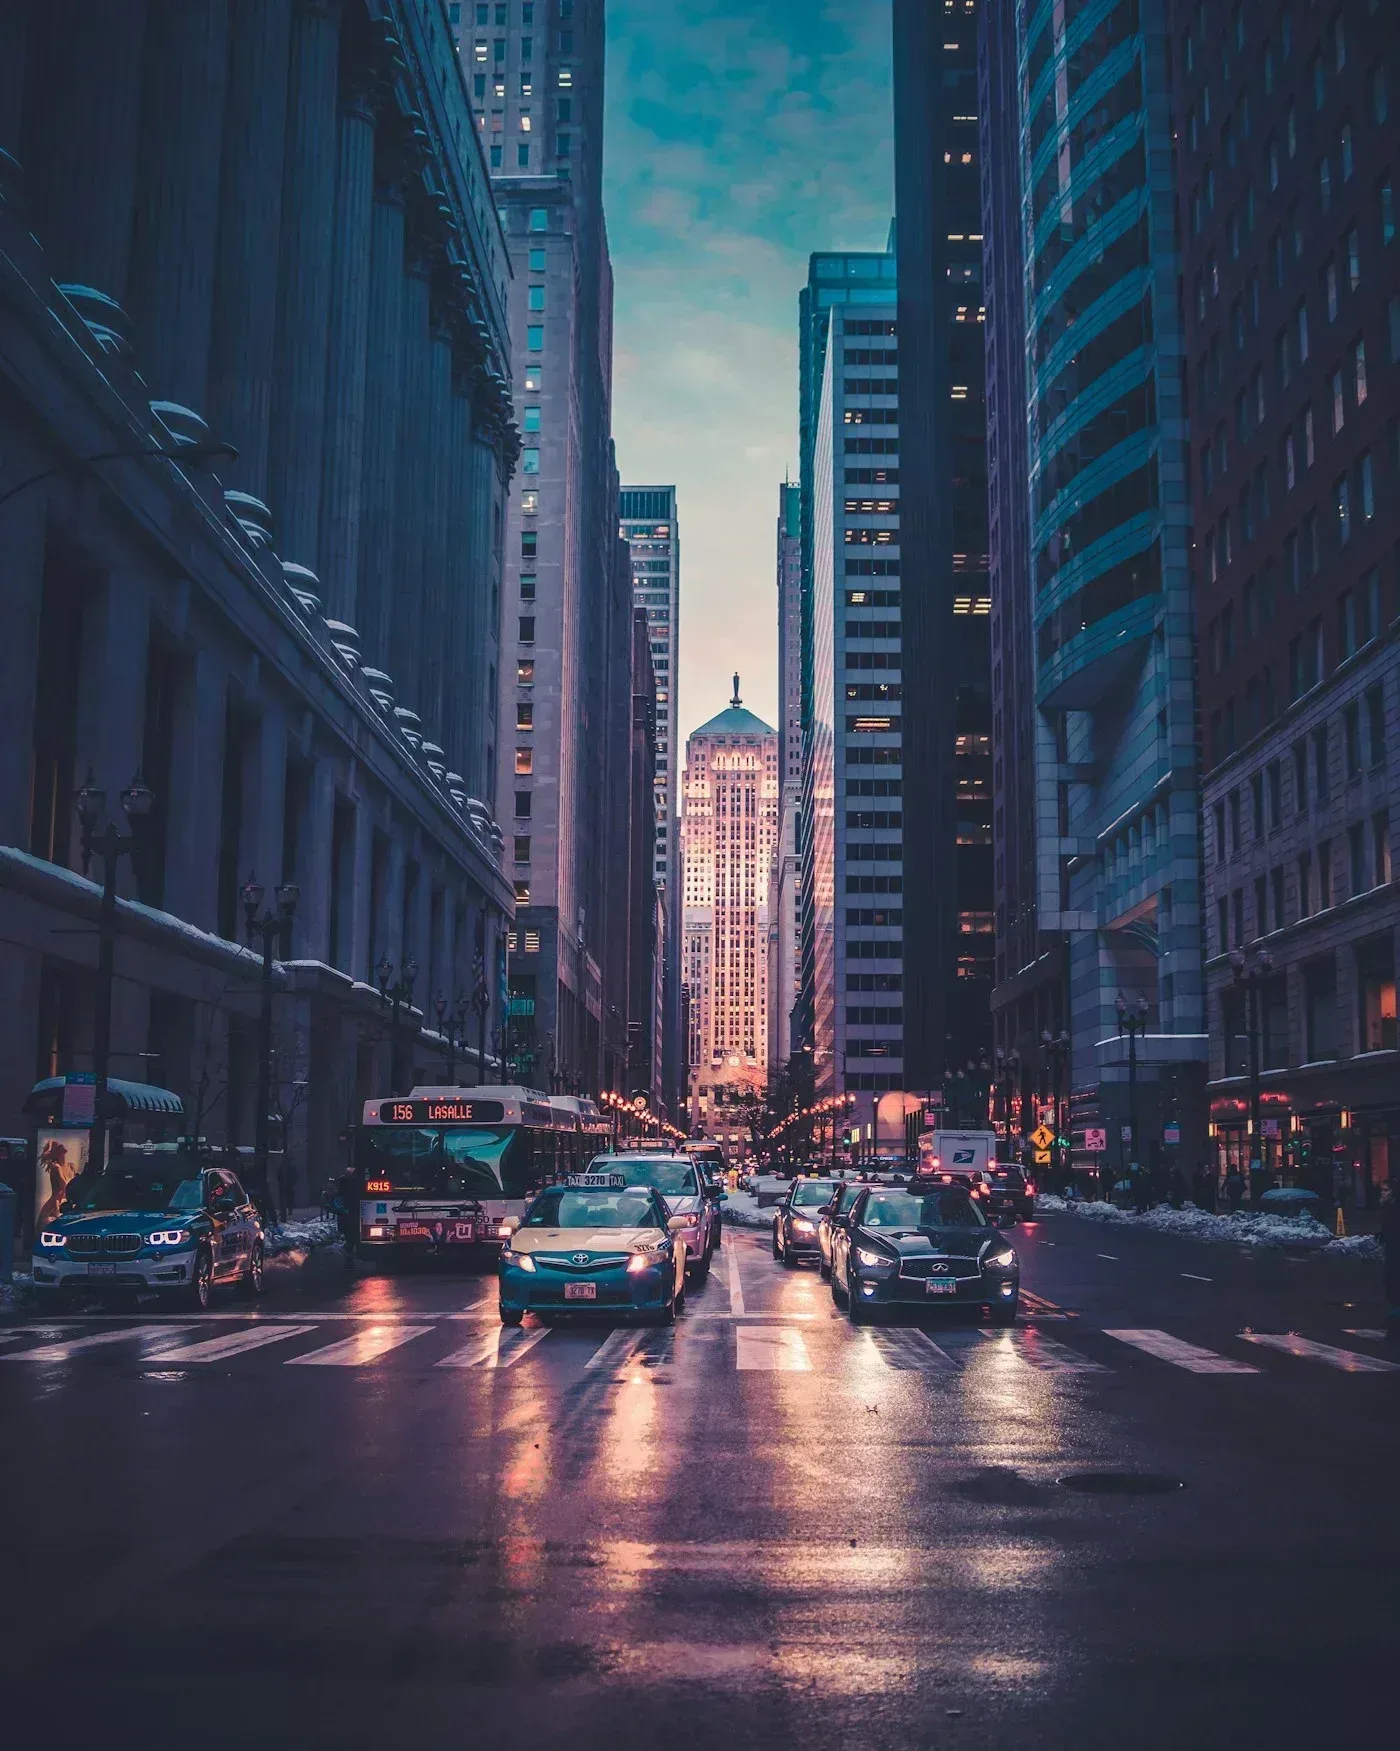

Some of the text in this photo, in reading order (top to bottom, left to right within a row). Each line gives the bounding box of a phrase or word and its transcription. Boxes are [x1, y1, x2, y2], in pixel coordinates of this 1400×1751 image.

[393, 1105, 472, 1120] 156 LASALLE
[367, 1181, 390, 1191] K915
[568, 1175, 624, 1186] TAXI 3270 TAXI
